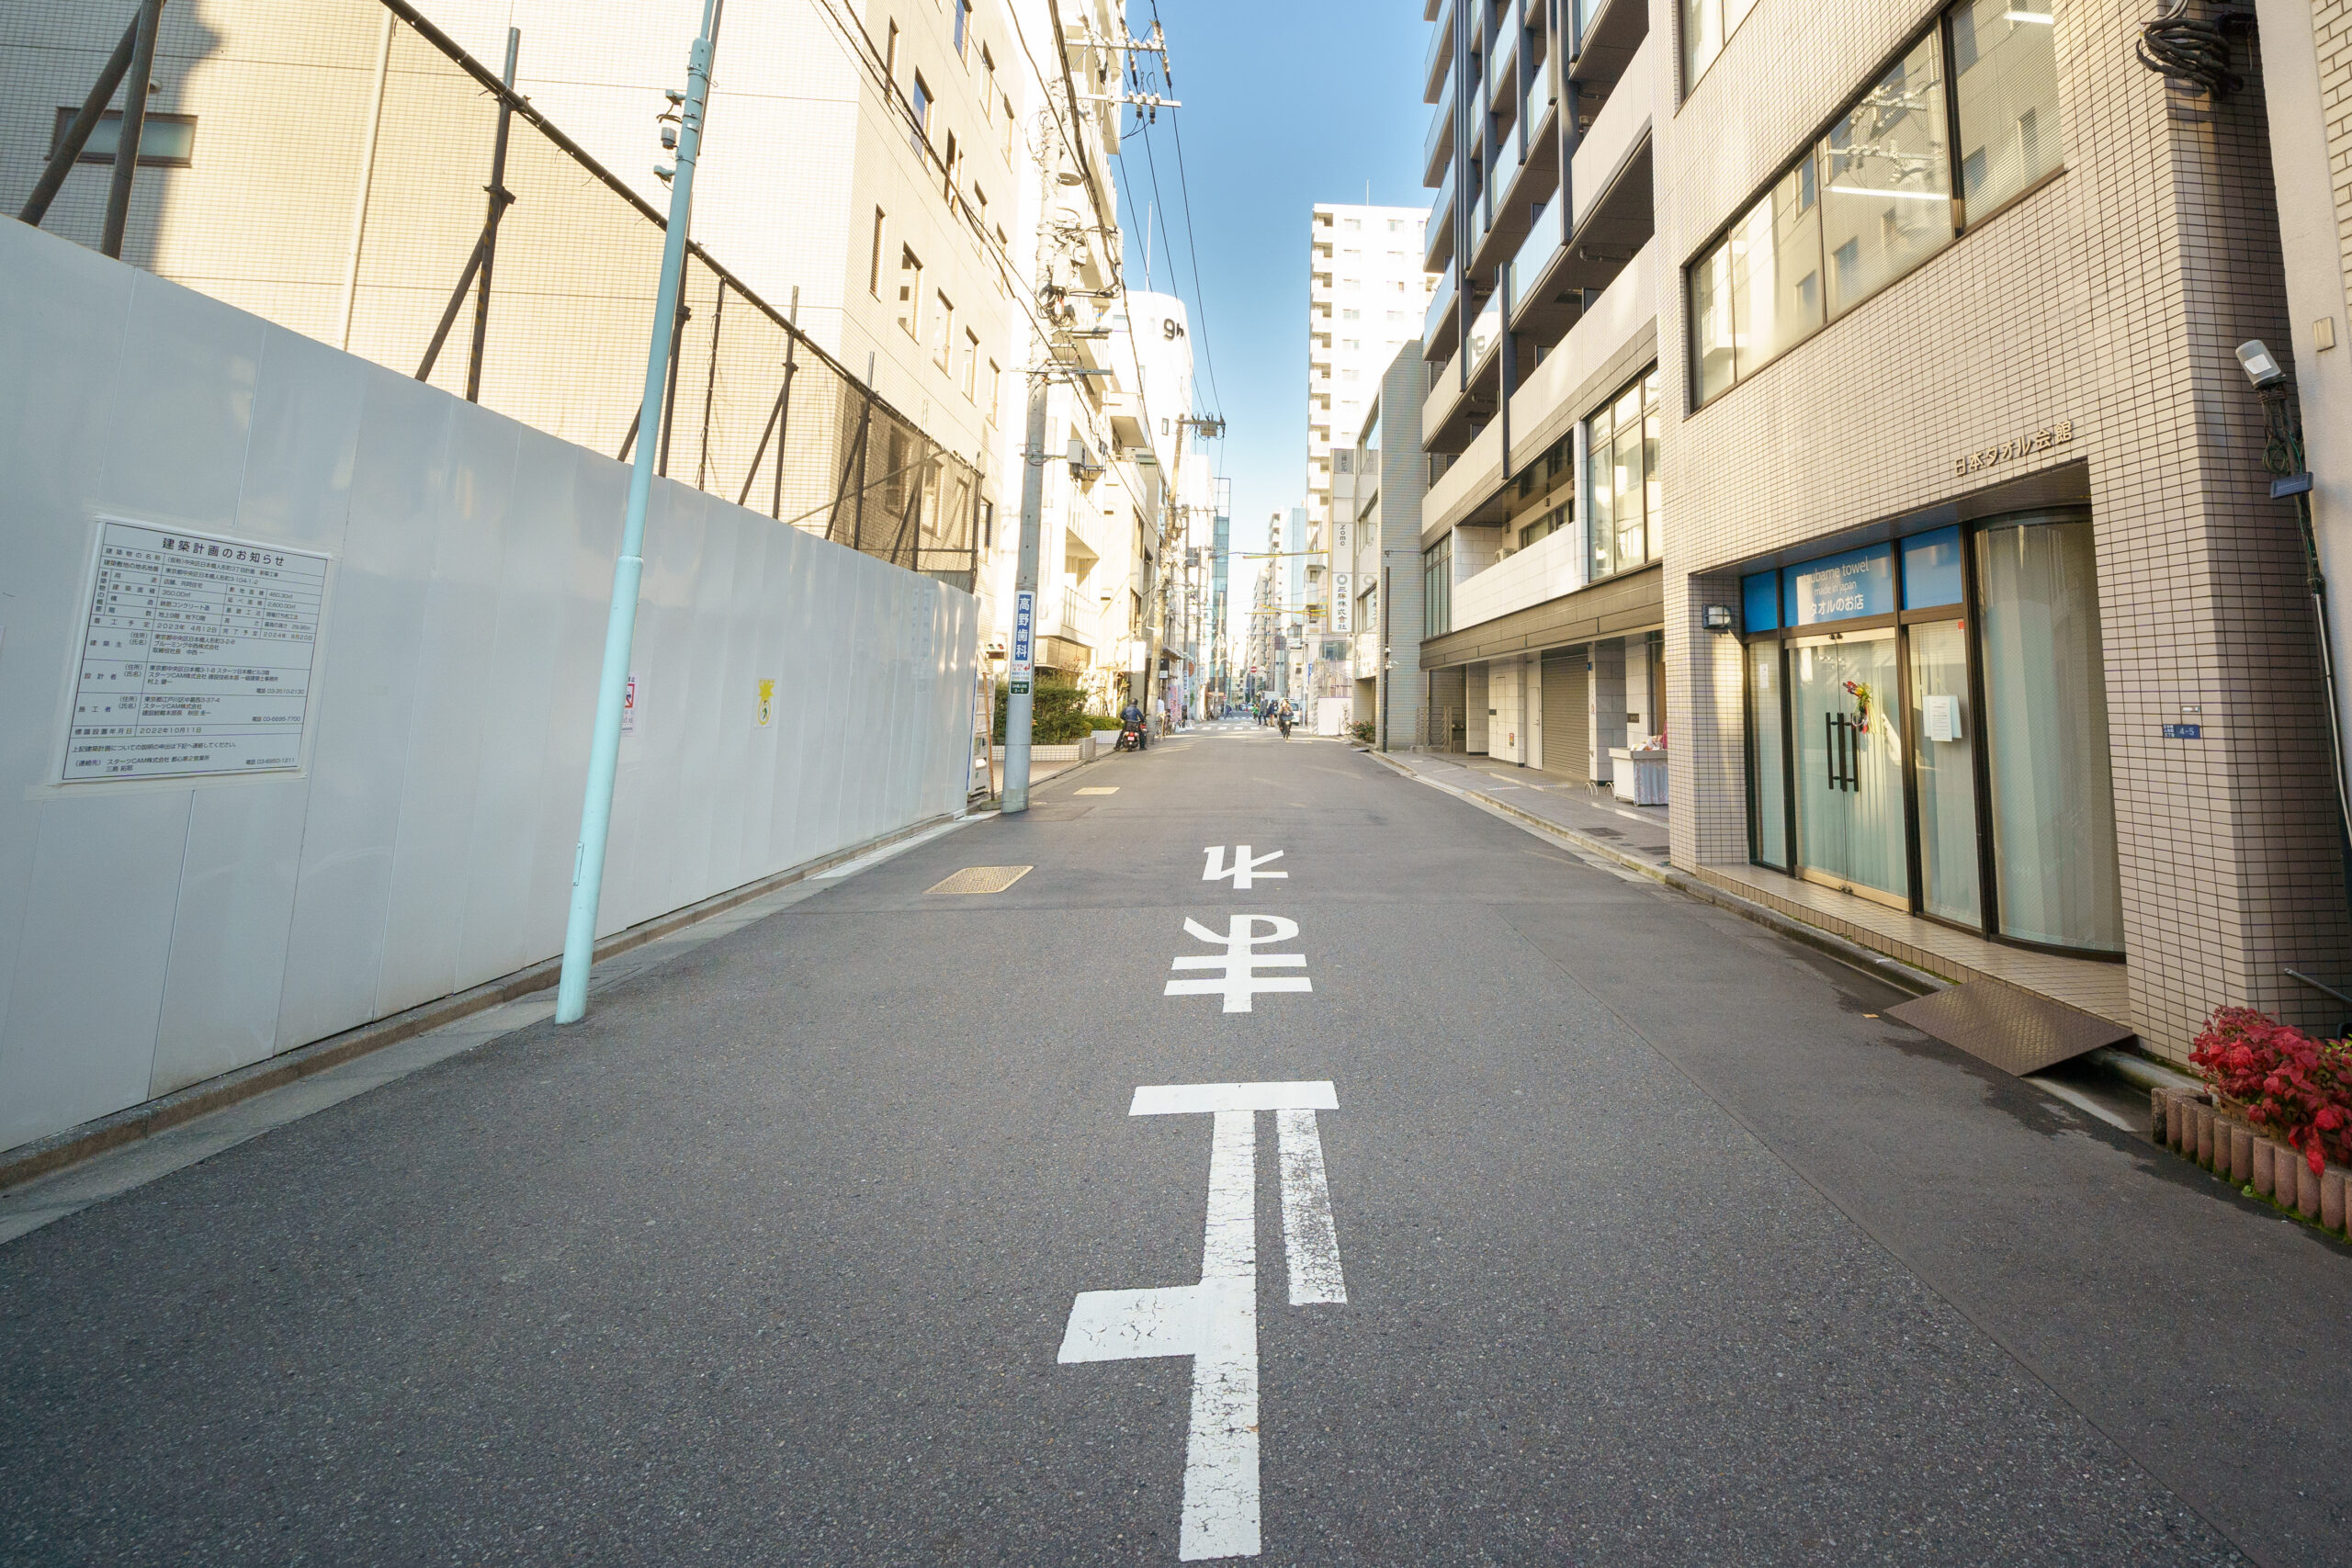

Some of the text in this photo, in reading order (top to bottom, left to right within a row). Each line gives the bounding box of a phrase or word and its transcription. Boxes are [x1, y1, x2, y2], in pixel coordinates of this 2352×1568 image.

[1953, 420, 2074, 477] 日本タオル会館
[105, 547, 161, 561] 建築物の名称
[161, 536, 285, 567] 建築計画のお知らせ
[1842, 556, 1870, 577] towel
[1814, 583, 1831, 596] made
[1808, 593, 1864, 617] タオルのお店
[1015, 597, 1031, 658] 高野歯科
[2179, 727, 2195, 736] 4-5
